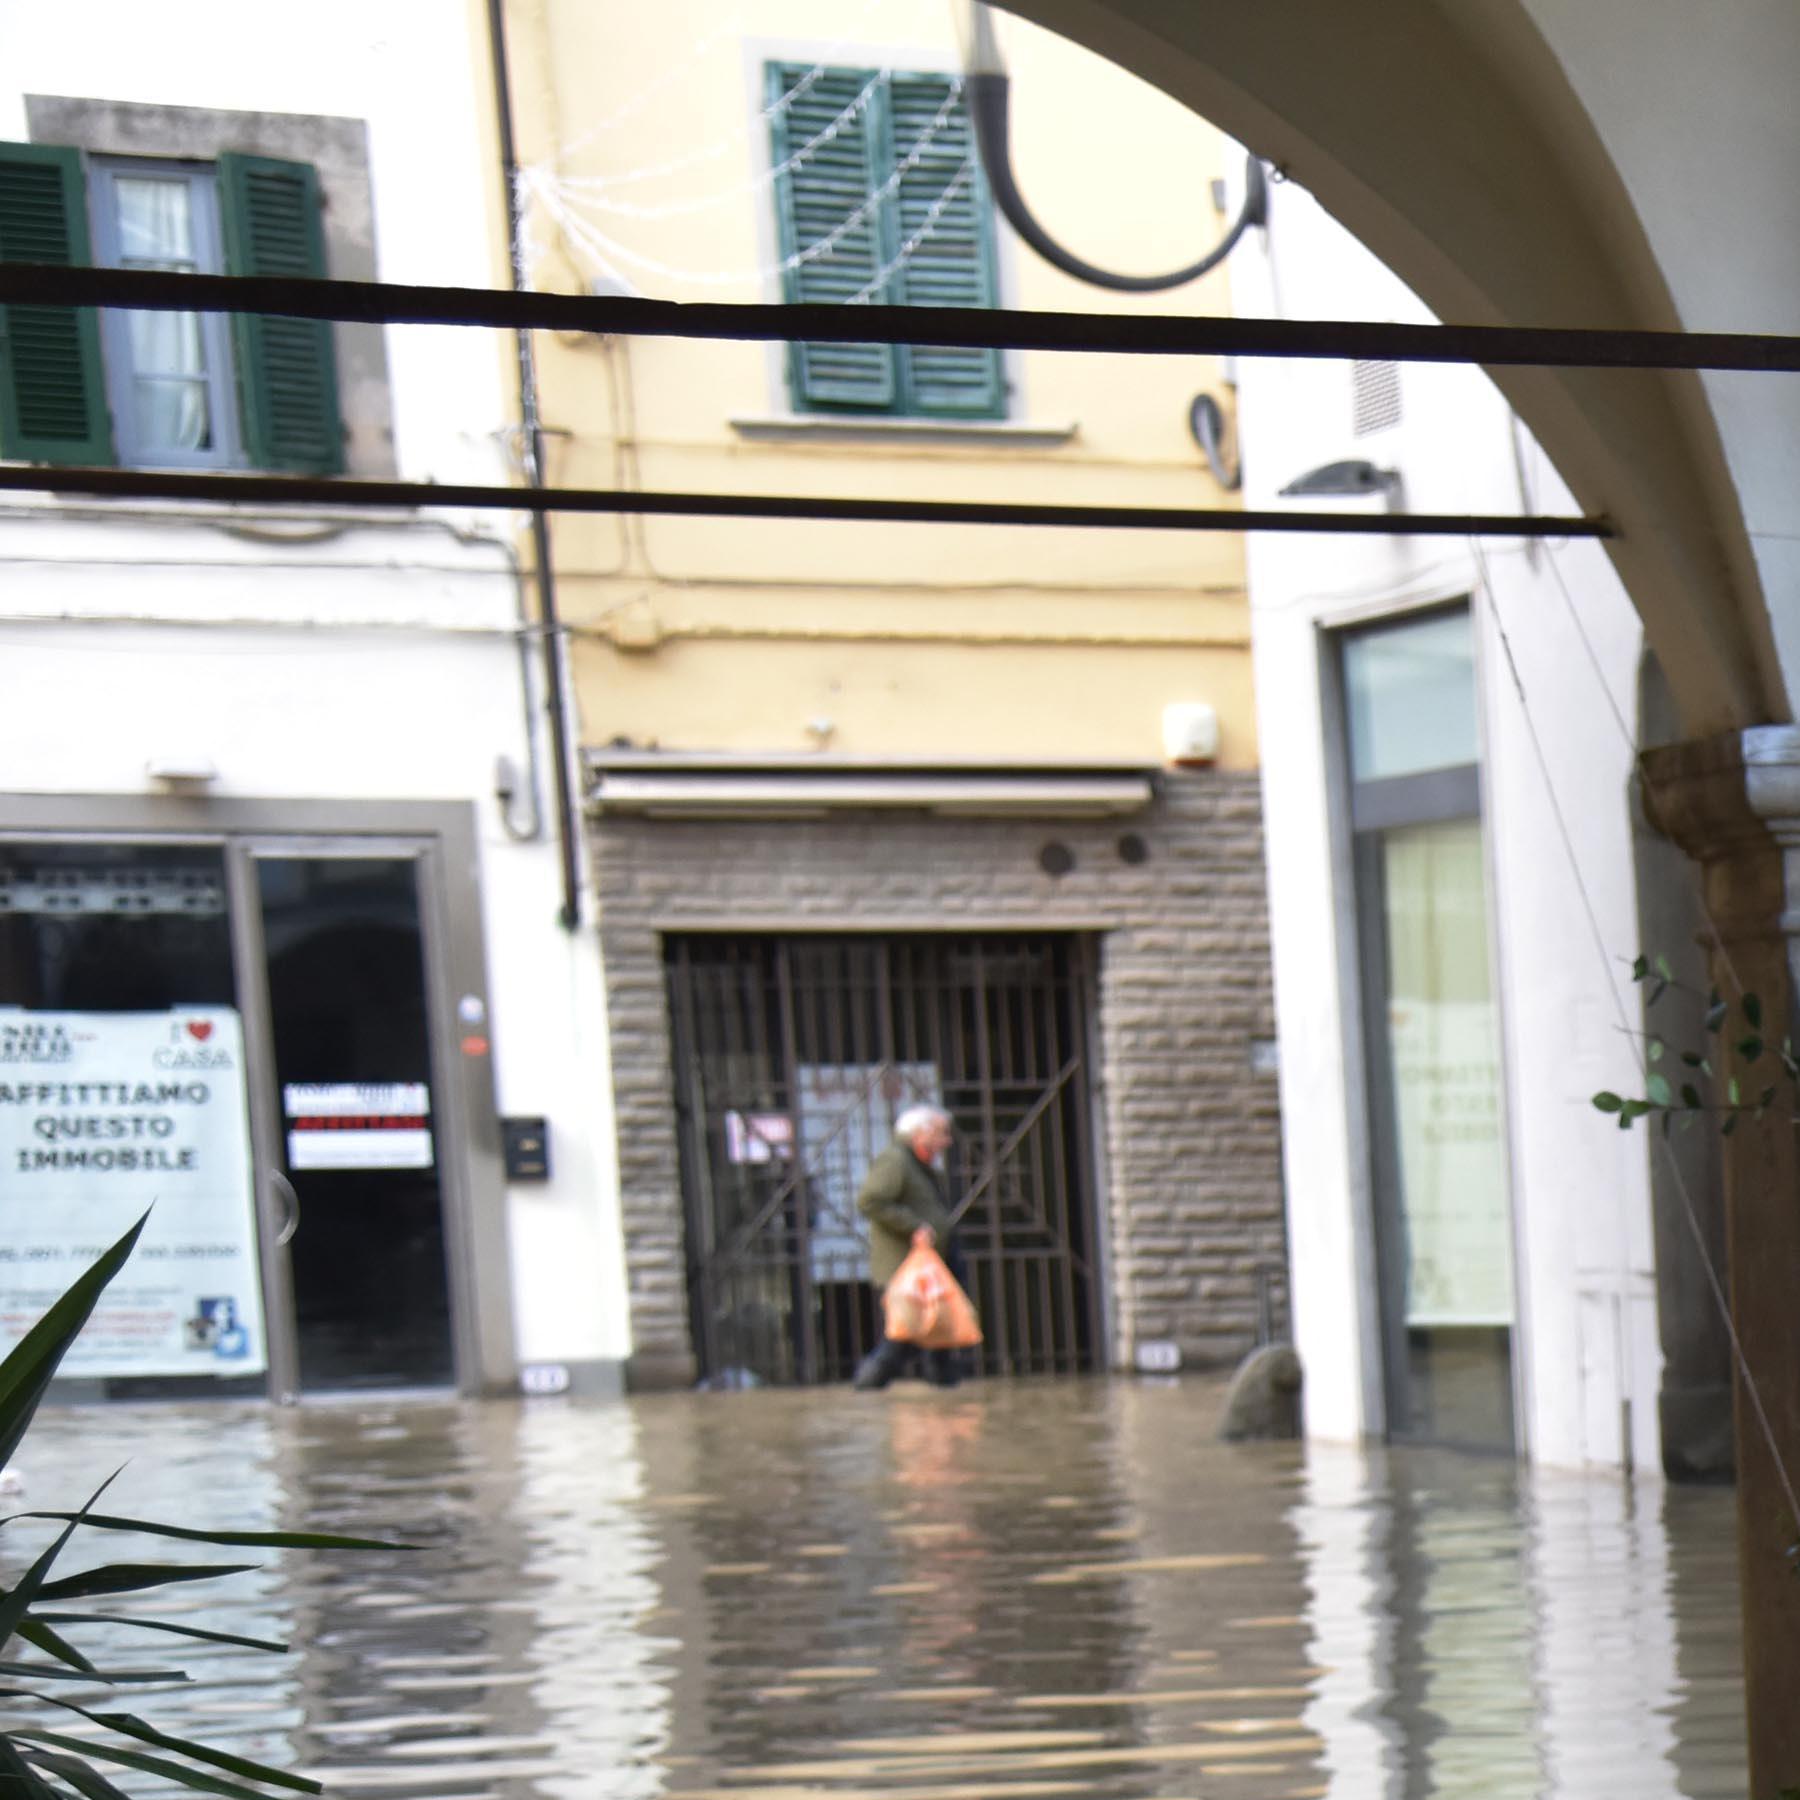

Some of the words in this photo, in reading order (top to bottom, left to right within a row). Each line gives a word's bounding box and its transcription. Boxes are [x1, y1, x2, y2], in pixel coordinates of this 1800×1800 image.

[152, 1047, 234, 1070] CASA
[0, 1082, 211, 1106] AFFITTIAMO
[34, 1115, 176, 1142] QUESTO
[16, 1148, 200, 1173] IMMOBILE
